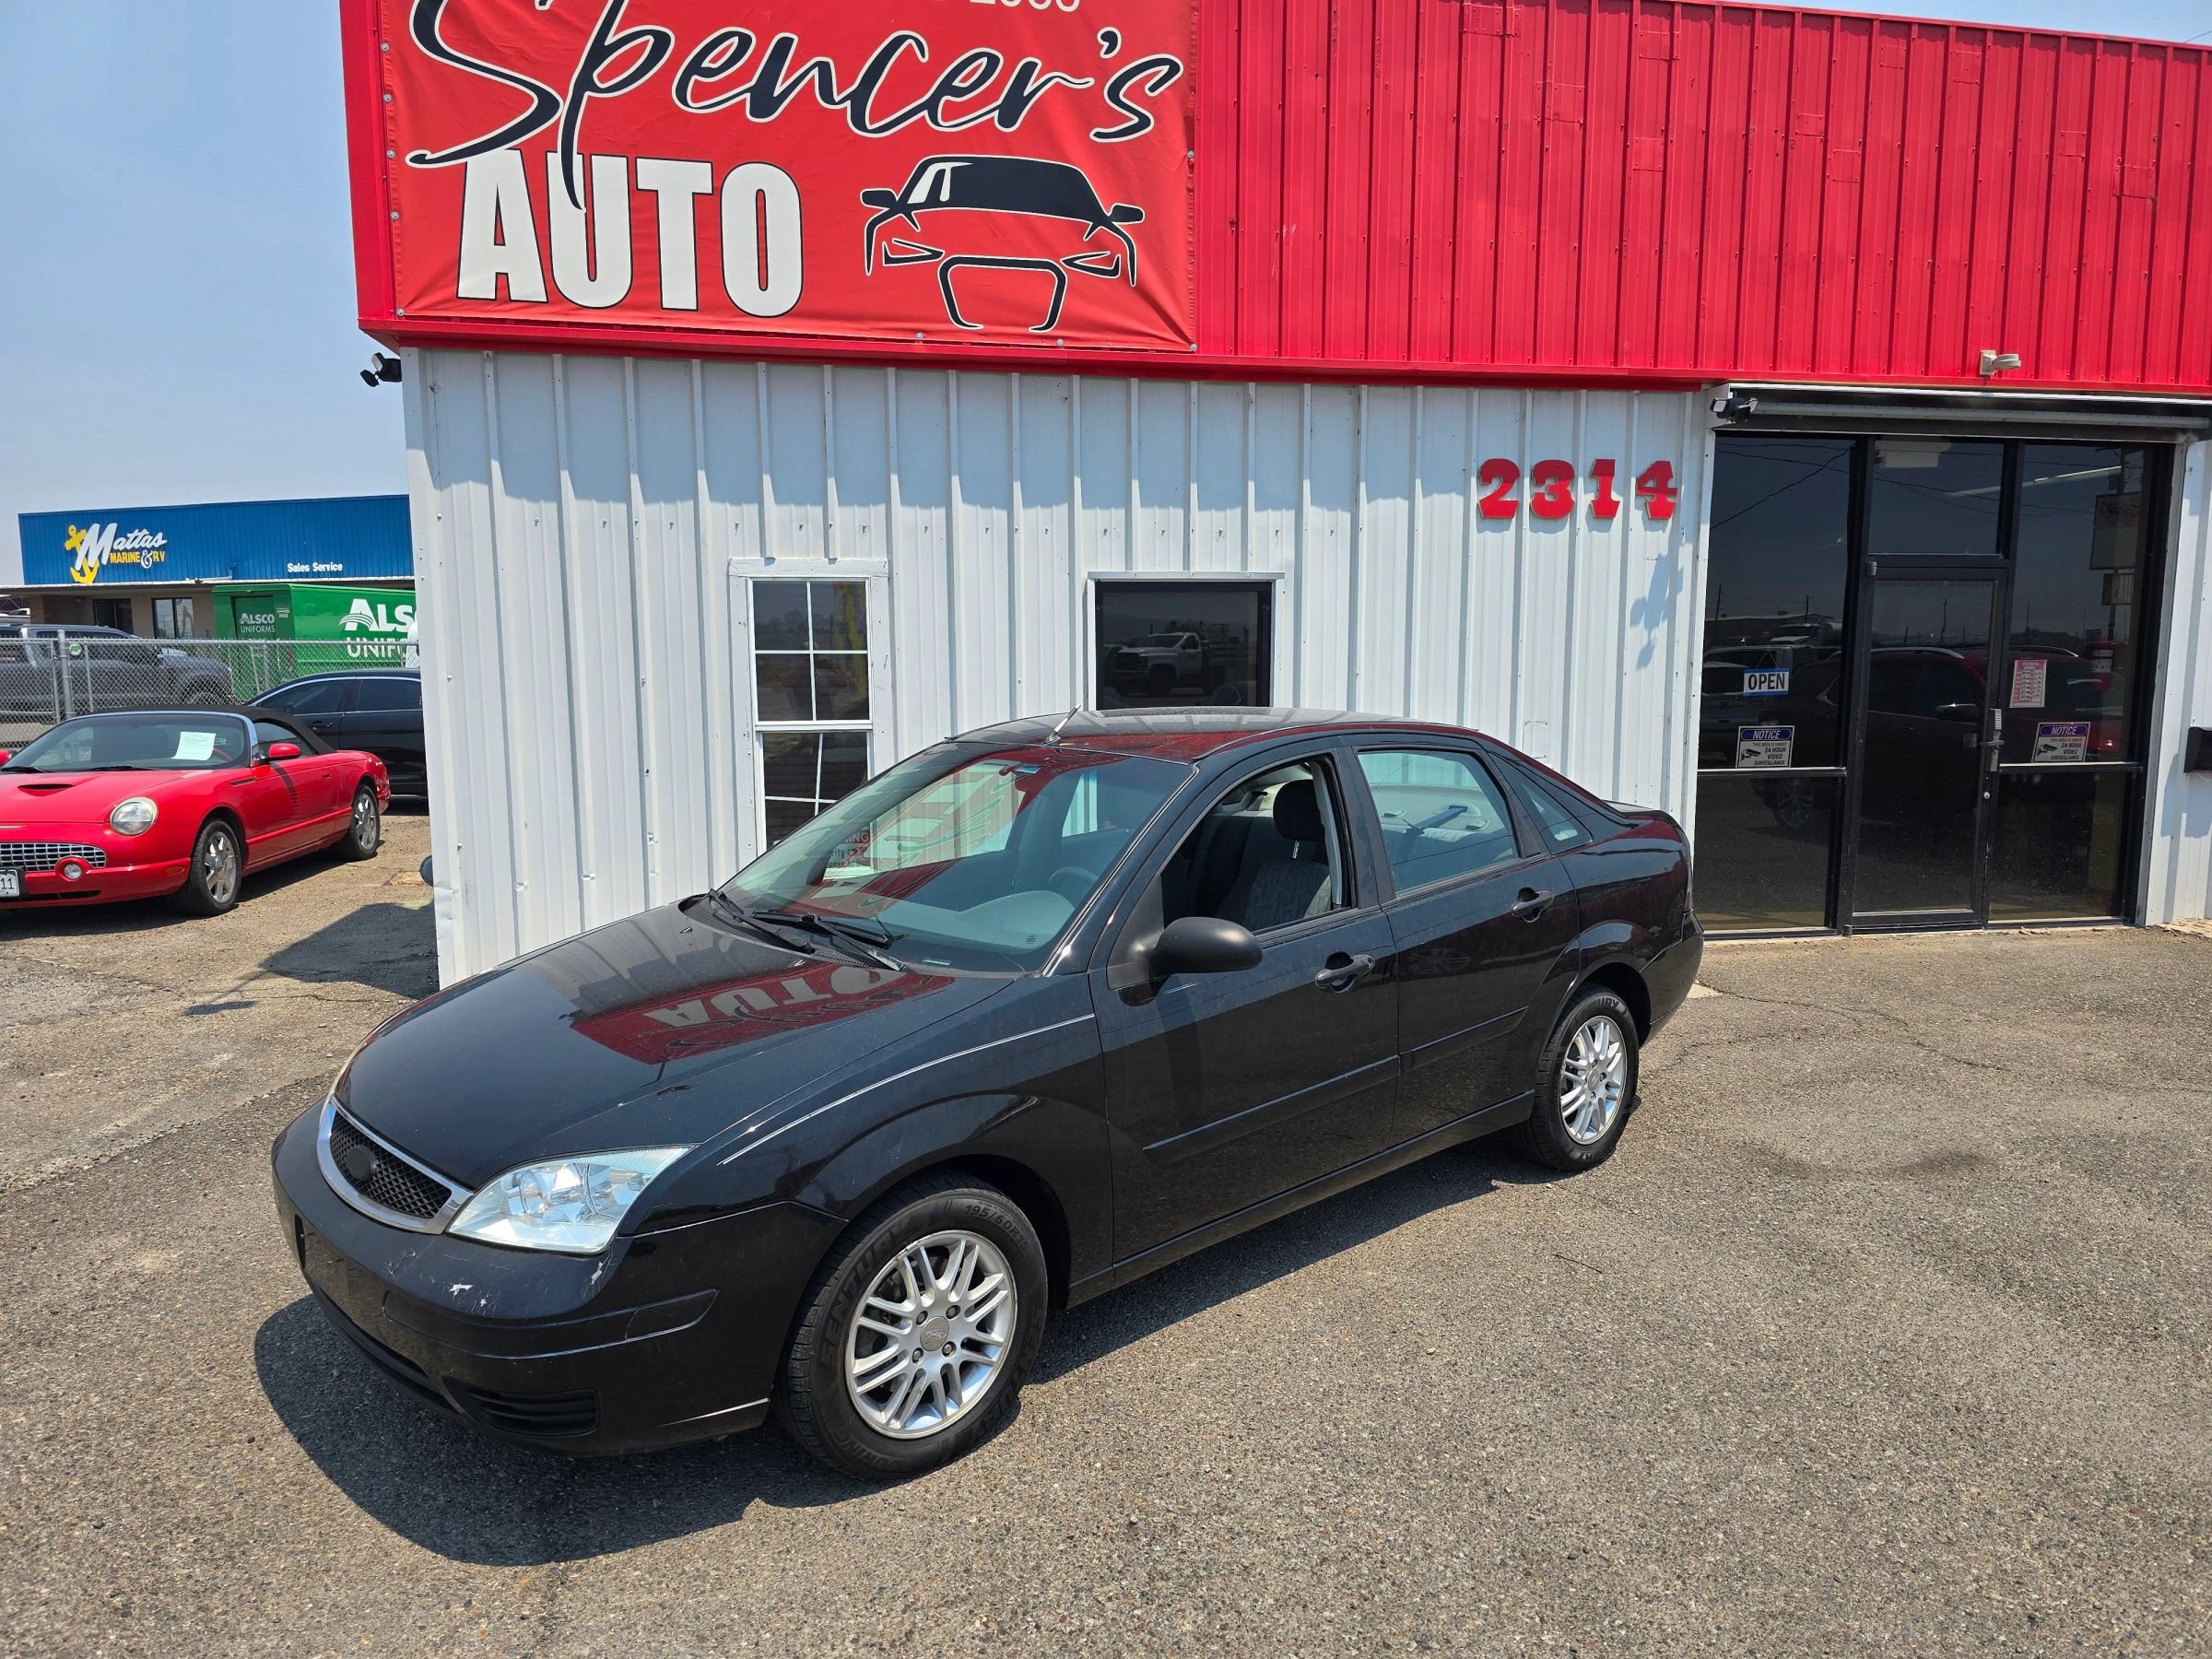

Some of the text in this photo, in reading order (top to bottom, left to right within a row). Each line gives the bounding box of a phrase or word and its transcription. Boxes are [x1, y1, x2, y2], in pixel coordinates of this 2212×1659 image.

[406, 0, 1183, 211] Spencer's
[455, 147, 803, 318] AUTO
[1477, 458, 1678, 520] 2314
[75, 523, 168, 571] Mattas
[110, 551, 140, 564] MARINE
[287, 561, 344, 573] Sales Service
[240, 612, 276, 625] ALSCO
[339, 598, 418, 633] ALS
[240, 625, 276, 634] UNIFORMS
[1747, 673, 1785, 691] OPEN
[1753, 730, 1781, 739] NOTICE
[2051, 726, 2077, 735] NOTICE
[965, 1205, 1030, 1251] 195/60R15
